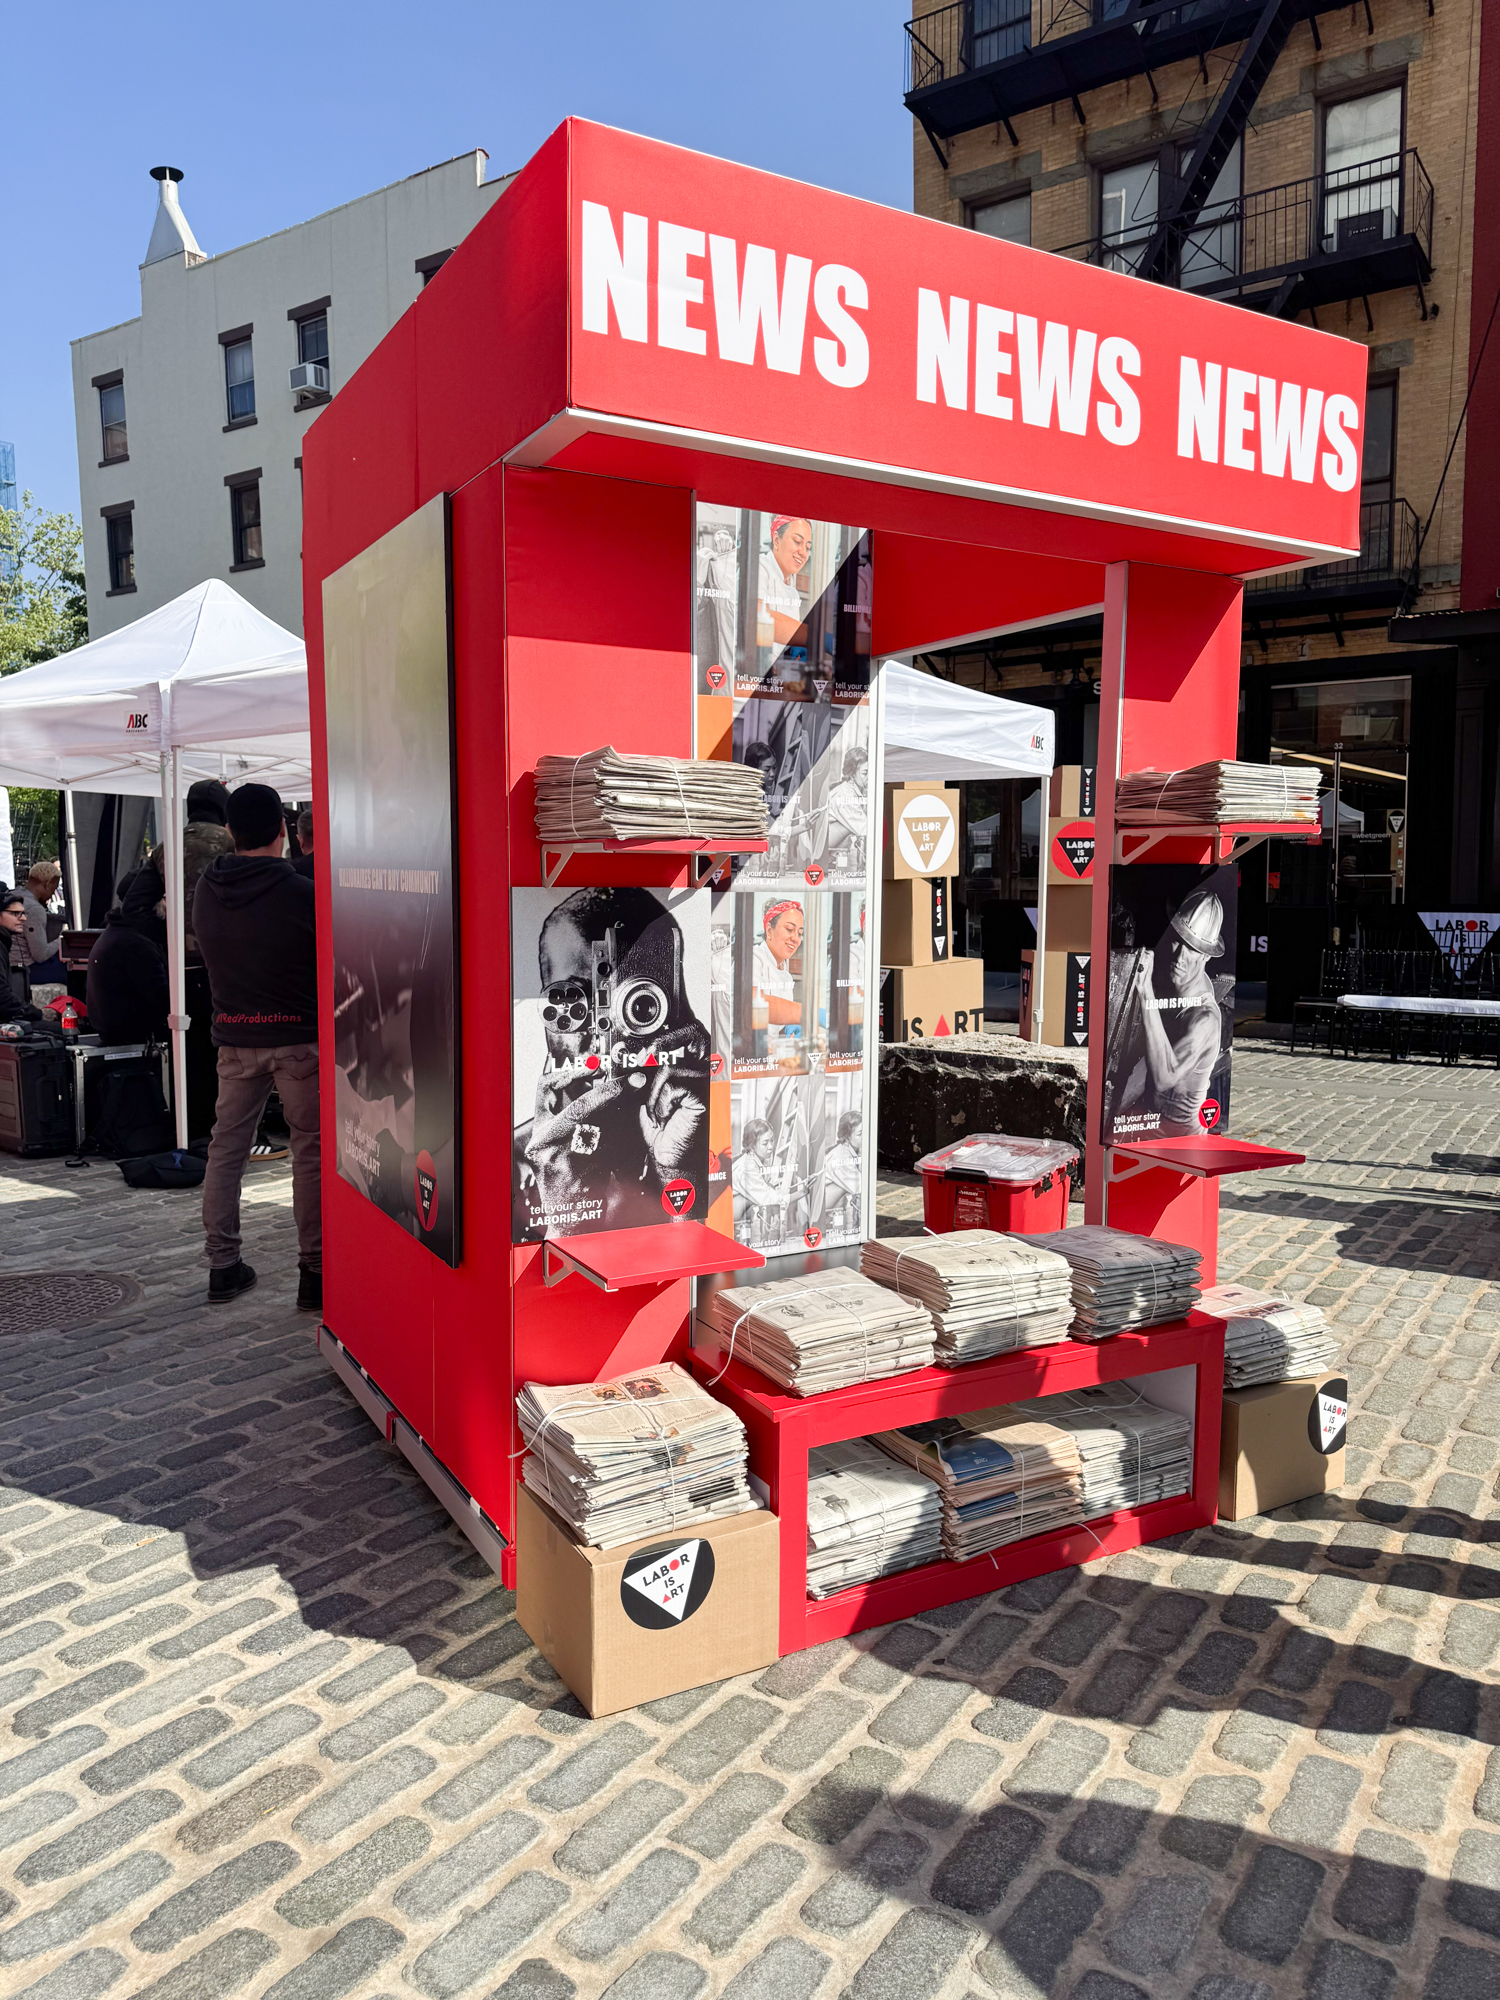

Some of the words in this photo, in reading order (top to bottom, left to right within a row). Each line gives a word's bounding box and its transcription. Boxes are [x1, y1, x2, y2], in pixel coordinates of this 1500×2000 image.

[582, 200, 870, 388] NEWS
[916, 289, 1141, 447] NEWS
[1177, 356, 1359, 493] NEWS
[736, 683, 784, 693] LABORIS.ART
[766, 677, 784, 686] story
[126, 714, 148, 728] ABC
[1031, 734, 1044, 750] ABC
[912, 822, 941, 832] LABOR
[922, 833, 930, 841] IS
[919, 843, 934, 851] ART
[339, 868, 371, 889] BILLIONAIRES
[388, 869, 400, 891] BUY
[400, 870, 439, 894] COMMUNITY
[1436, 919, 1489, 931] LABOR
[1146, 998, 1168, 1010] LABOR
[1169, 998, 1177, 1008] IS
[1178, 996, 1202, 1008] POWER
[903, 1017, 923, 1042] IS
[934, 1008, 984, 1036] ART
[552, 1054, 612, 1072] LABOR
[622, 1053, 638, 1068] IS
[644, 1050, 680, 1067] ART
[746, 1057, 761, 1065] your
[734, 1064, 779, 1073] LABORIS.ART
[1114, 1115, 1126, 1124] tell
[1126, 1114, 1142, 1124] your
[1113, 1121, 1161, 1134] LABORIS.ART
[345, 1118, 353, 1136] tell
[354, 1126, 366, 1142] your
[366, 1134, 380, 1157] story
[345, 1139, 380, 1177] LABORIS.ART
[420, 1175, 433, 1192] LABOR
[530, 1203, 547, 1215] tell
[551, 1202, 574, 1214] your
[576, 1199, 603, 1209] story
[530, 1209, 603, 1227] LABORIS.ART
[1323, 1402, 1346, 1417] LABOR
[1323, 1426, 1336, 1434] ART
[643, 1554, 690, 1586] LABOR
[664, 1576, 675, 1588] IS
[662, 1583, 684, 1604] ART
